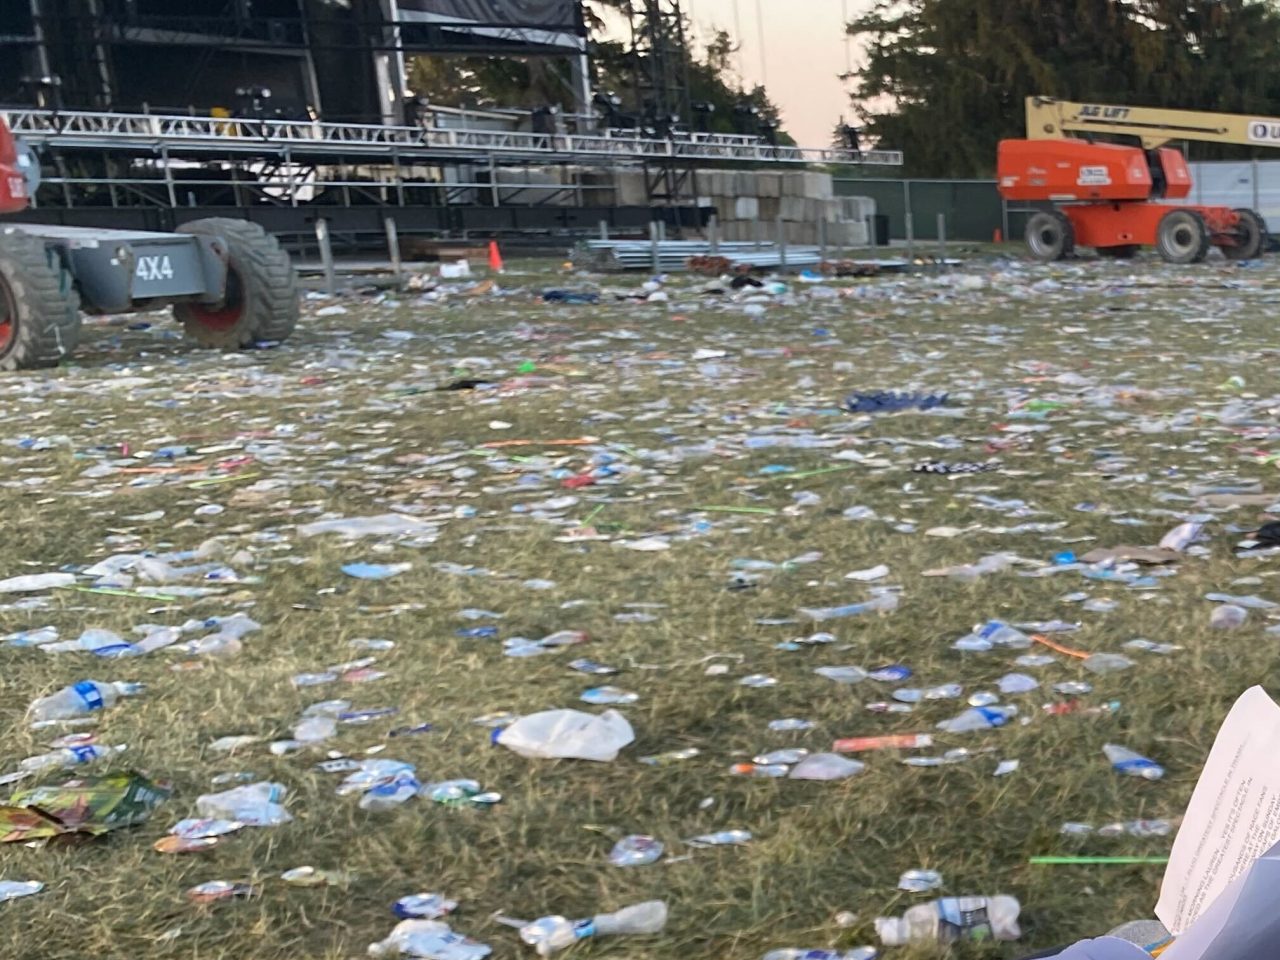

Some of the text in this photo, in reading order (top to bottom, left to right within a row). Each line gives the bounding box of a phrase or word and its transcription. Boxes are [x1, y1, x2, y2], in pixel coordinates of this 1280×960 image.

[135, 256, 174, 281] 4X4
[1249, 808, 1258, 830] RACE
[1257, 786, 1266, 806] FANS
[1262, 794, 1279, 827] SUNDAY
[1188, 880, 1204, 916] MORNING
[1203, 849, 1219, 879] LAUREN
[1233, 779, 1249, 807] OFTEN
[1212, 834, 1231, 874] GREATEST
[1225, 788, 1248, 832] SPECTACLE
